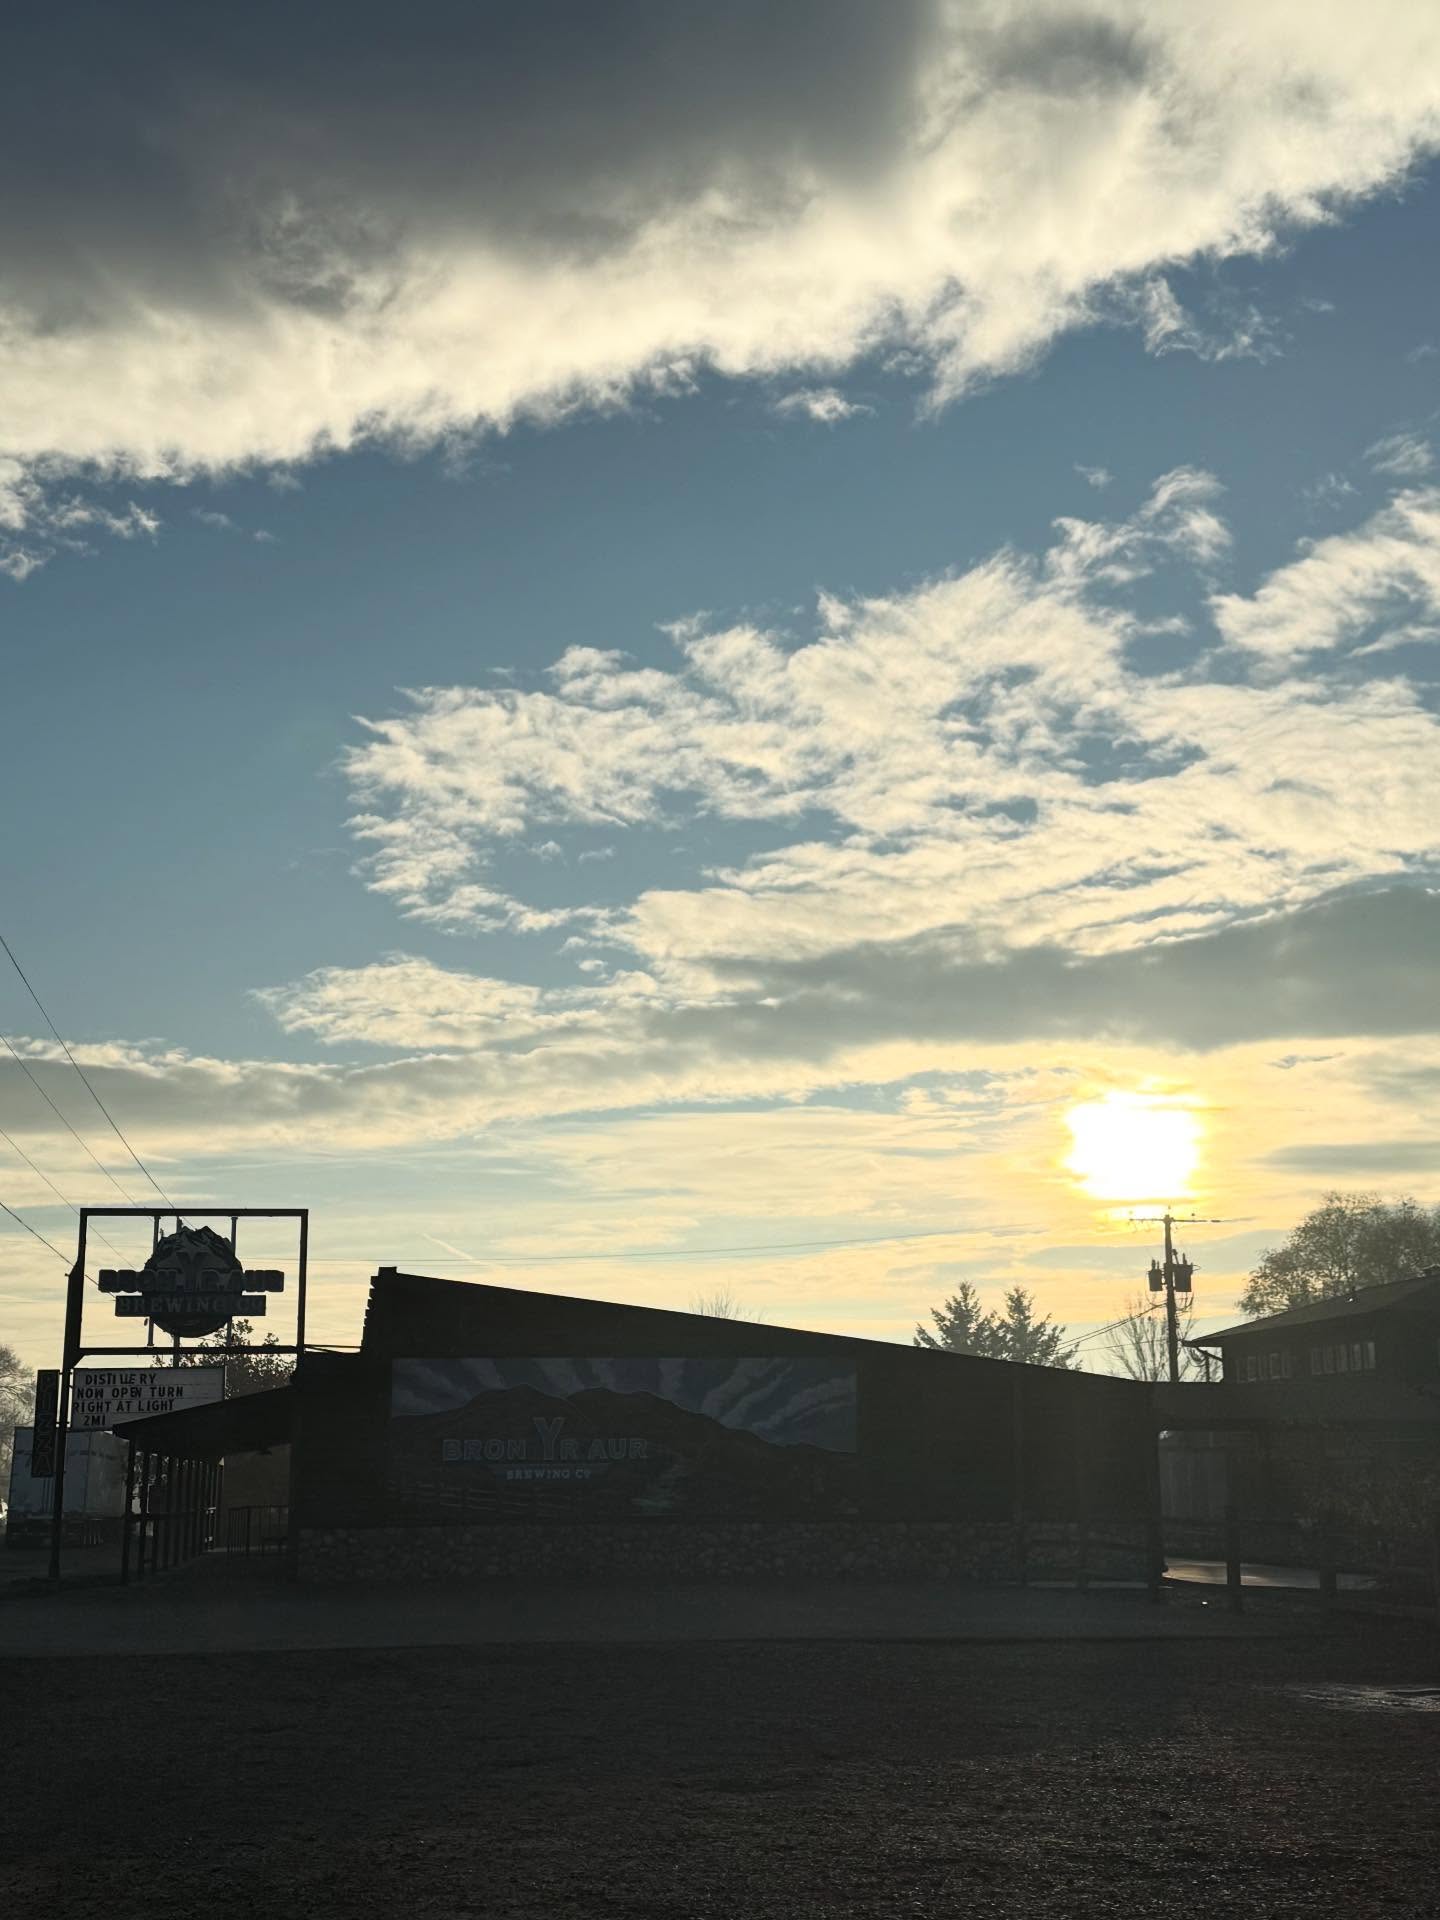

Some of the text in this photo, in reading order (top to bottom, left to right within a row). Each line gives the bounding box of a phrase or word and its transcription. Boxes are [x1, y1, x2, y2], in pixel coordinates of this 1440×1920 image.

[119, 1297, 225, 1313] BREWING
[85, 1373, 157, 1385] DISTILLERY
[77, 1386, 184, 1399] NOW OPEN TURN
[72, 1399, 175, 1413] RIGHT AT LIGHT
[442, 1439, 527, 1461] BRON
[587, 1438, 649, 1460] AUR
[506, 1468, 570, 1480] BREWING
